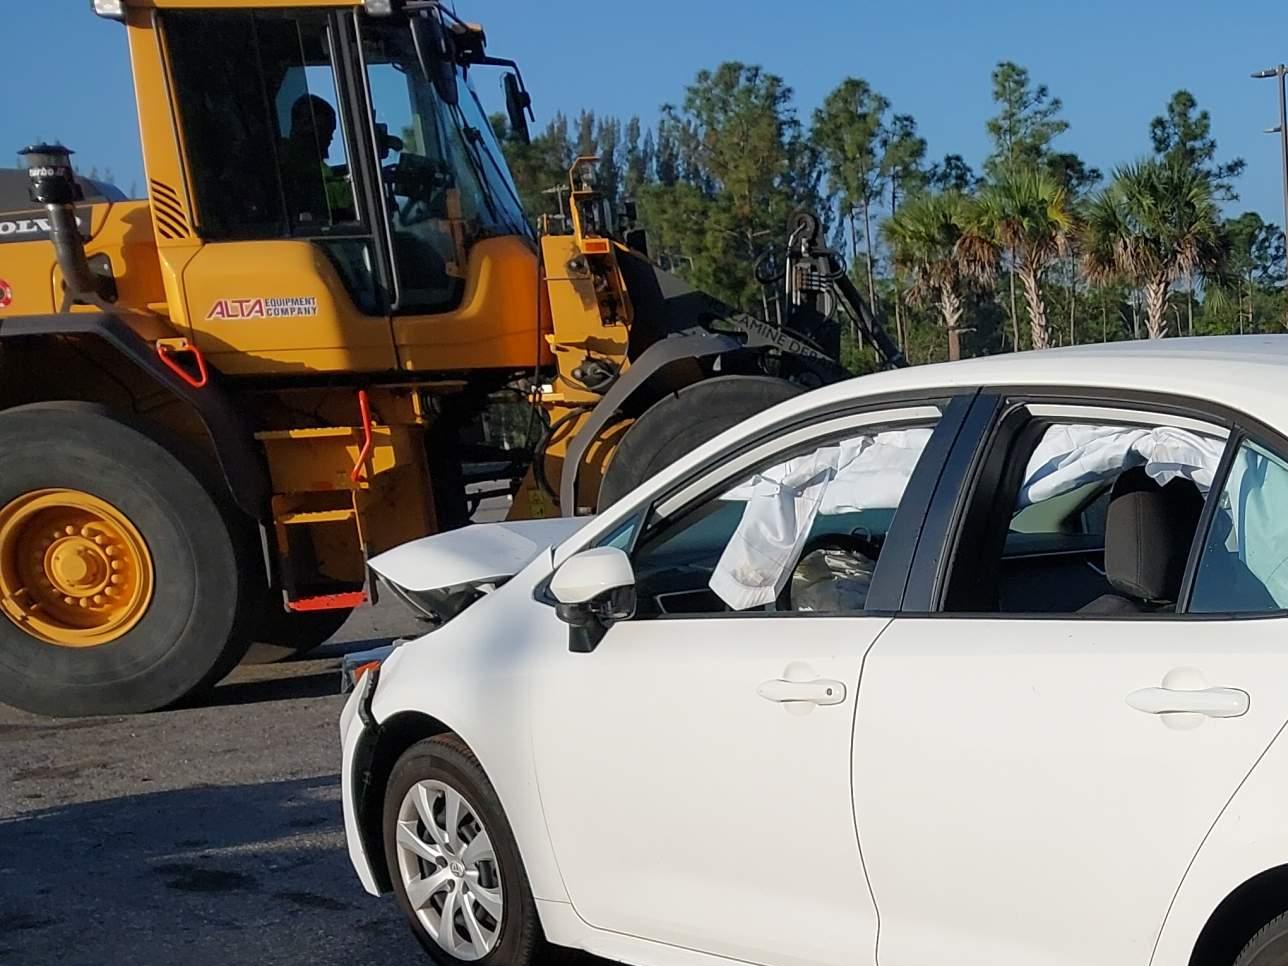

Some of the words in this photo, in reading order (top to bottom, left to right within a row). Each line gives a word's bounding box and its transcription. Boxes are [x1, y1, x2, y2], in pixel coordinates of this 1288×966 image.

[0, 216, 81, 235] OLV
[206, 299, 265, 319] ALTA
[264, 297, 316, 307] EQUIPMENT
[266, 306, 318, 317] COMPANY
